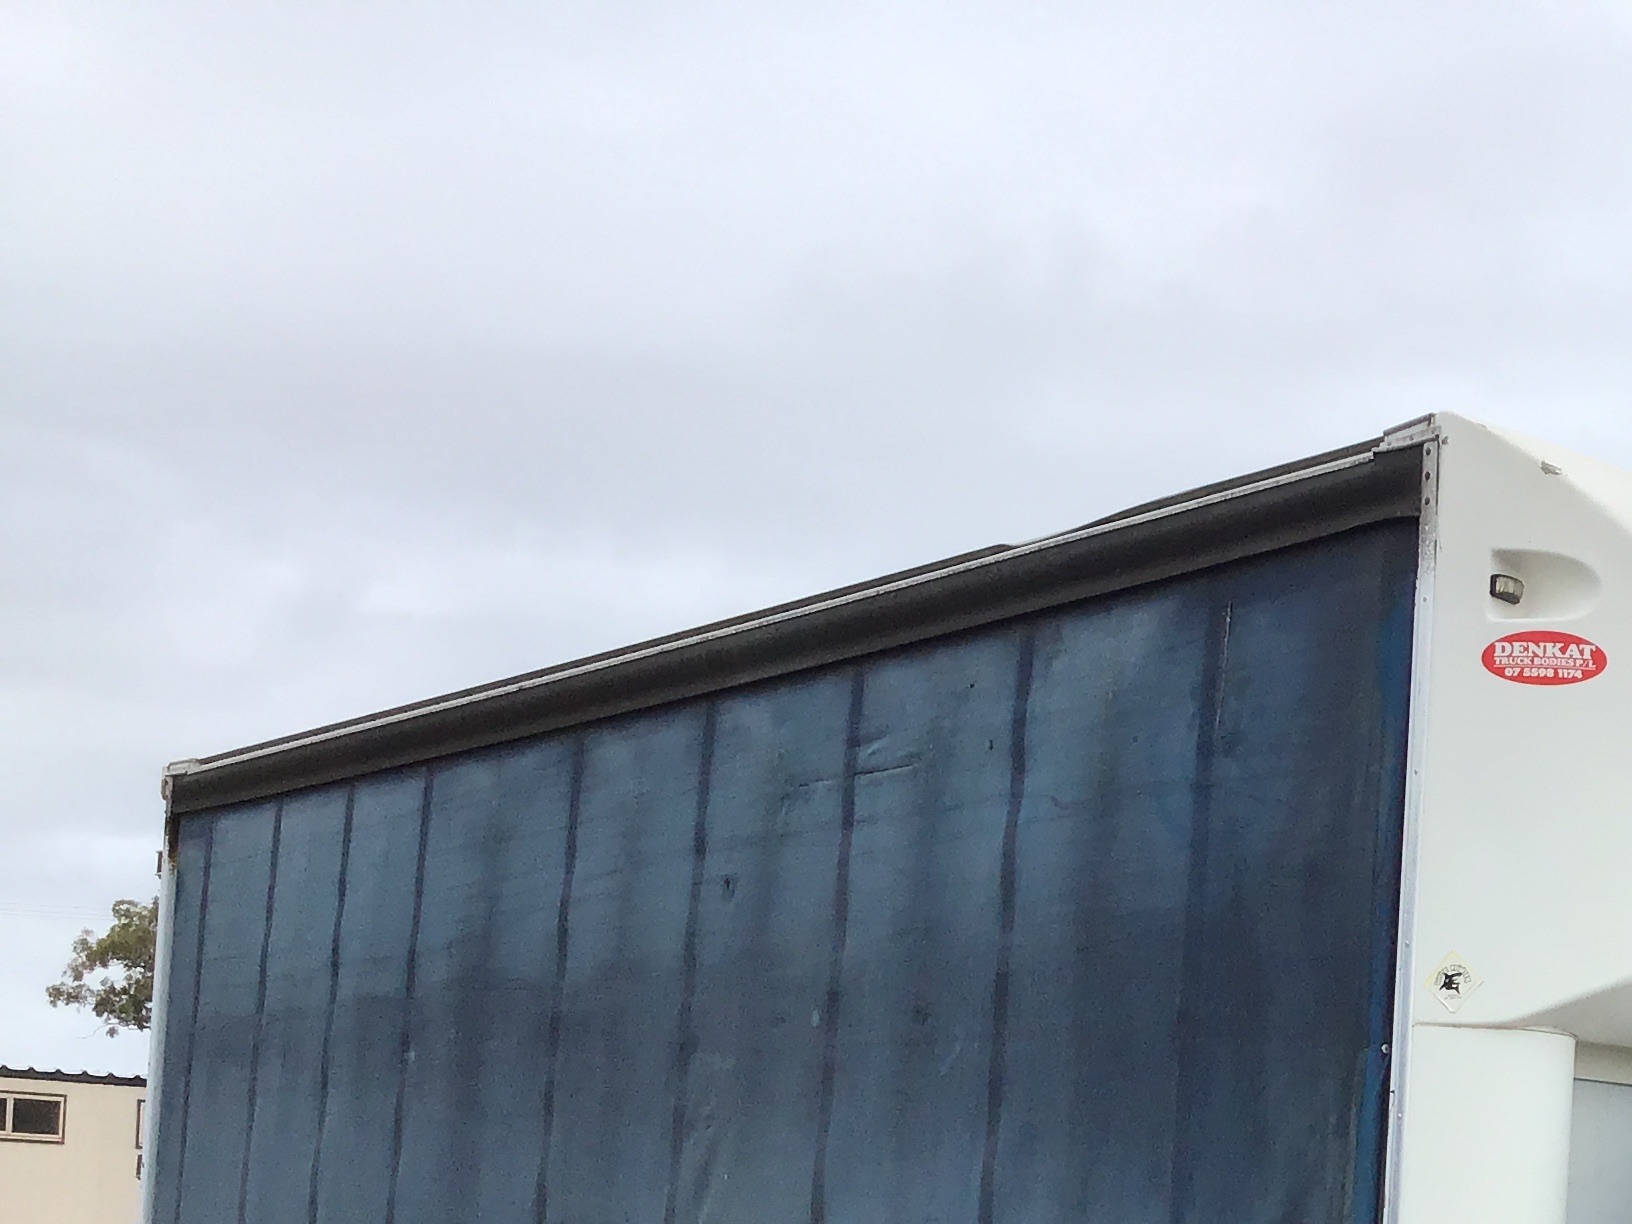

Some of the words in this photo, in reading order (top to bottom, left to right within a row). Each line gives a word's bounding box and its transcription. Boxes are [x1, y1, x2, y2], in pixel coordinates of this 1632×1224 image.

[1494, 641, 1596, 660] DENKAT
[1494, 657, 1532, 665] TRUCK
[1533, 657, 1575, 667] BODIES
[1576, 658, 1596, 668] P/L
[1504, 667, 1520, 677] 07
[1522, 668, 1555, 678] 5598
[1558, 669, 1582, 679] 1174
